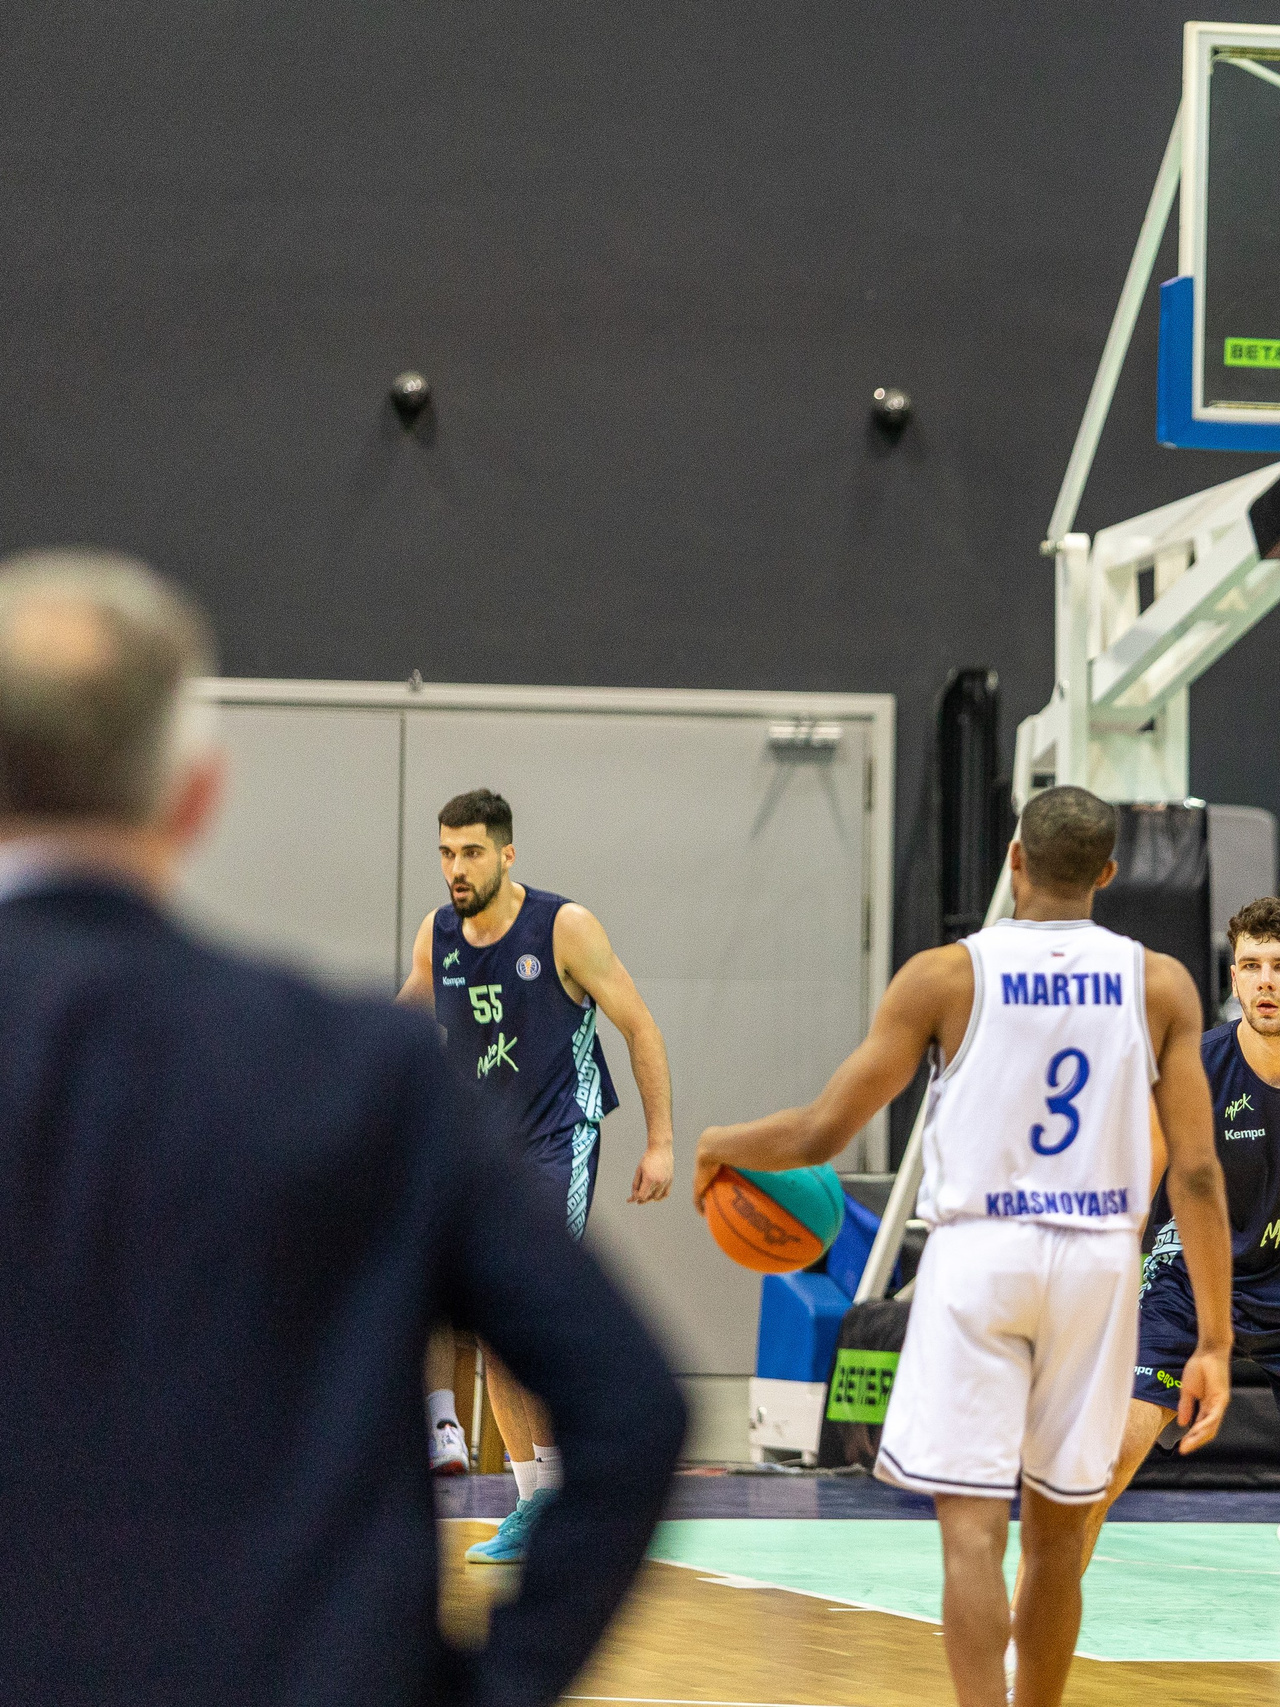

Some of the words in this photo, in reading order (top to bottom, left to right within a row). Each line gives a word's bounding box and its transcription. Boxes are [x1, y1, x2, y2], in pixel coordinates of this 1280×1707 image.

[468, 984, 503, 1025] 55
[1001, 972, 1123, 1007] MARTIN
[1030, 1047, 1091, 1157] 3
[1224, 1128, 1266, 1141] Kempa
